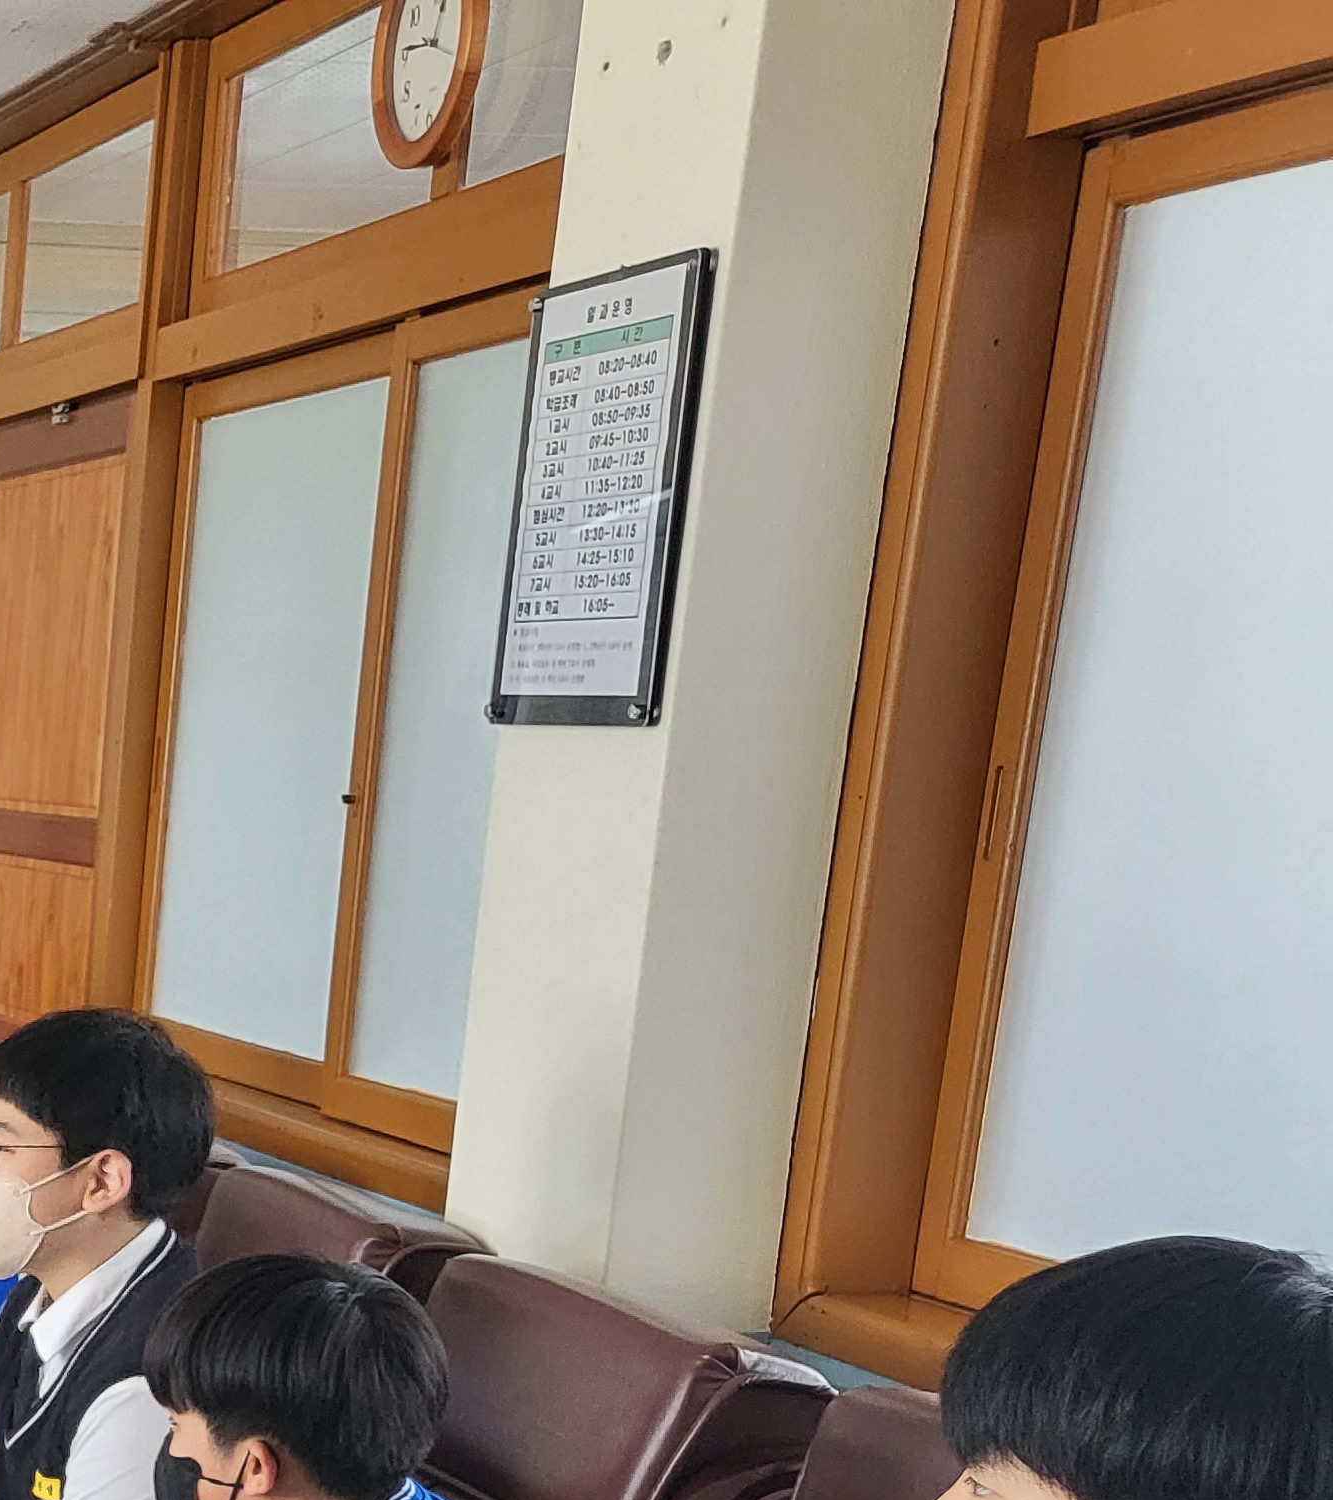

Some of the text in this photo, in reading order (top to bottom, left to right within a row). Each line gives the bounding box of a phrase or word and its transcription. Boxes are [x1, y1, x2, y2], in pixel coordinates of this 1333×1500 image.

[410, 4, 421, 28] 10
[403, 80, 411, 103] 8
[414, 103, 421, 126] 7
[549, 350, 657, 387] 등교시간 08:20-08:40
[594, 379, 655, 404] 08:40-08:50
[549, 403, 651, 434] 1교시 08:50-09:35
[545, 427, 649, 456] 2교시 09:45-10:30
[542, 450, 646, 479] 3교시 10:40-11:25
[541, 474, 643, 500] 4교시 11:35-12:20
[533, 507, 565, 525] 점심시간
[535, 523, 637, 547] 5교시 13:30-14:15
[532, 547, 634, 570] 6교시 14:25-15:10
[530, 572, 631, 592] 7교시 15:20-16:05
[583, 598, 614, 613] 16:05-
